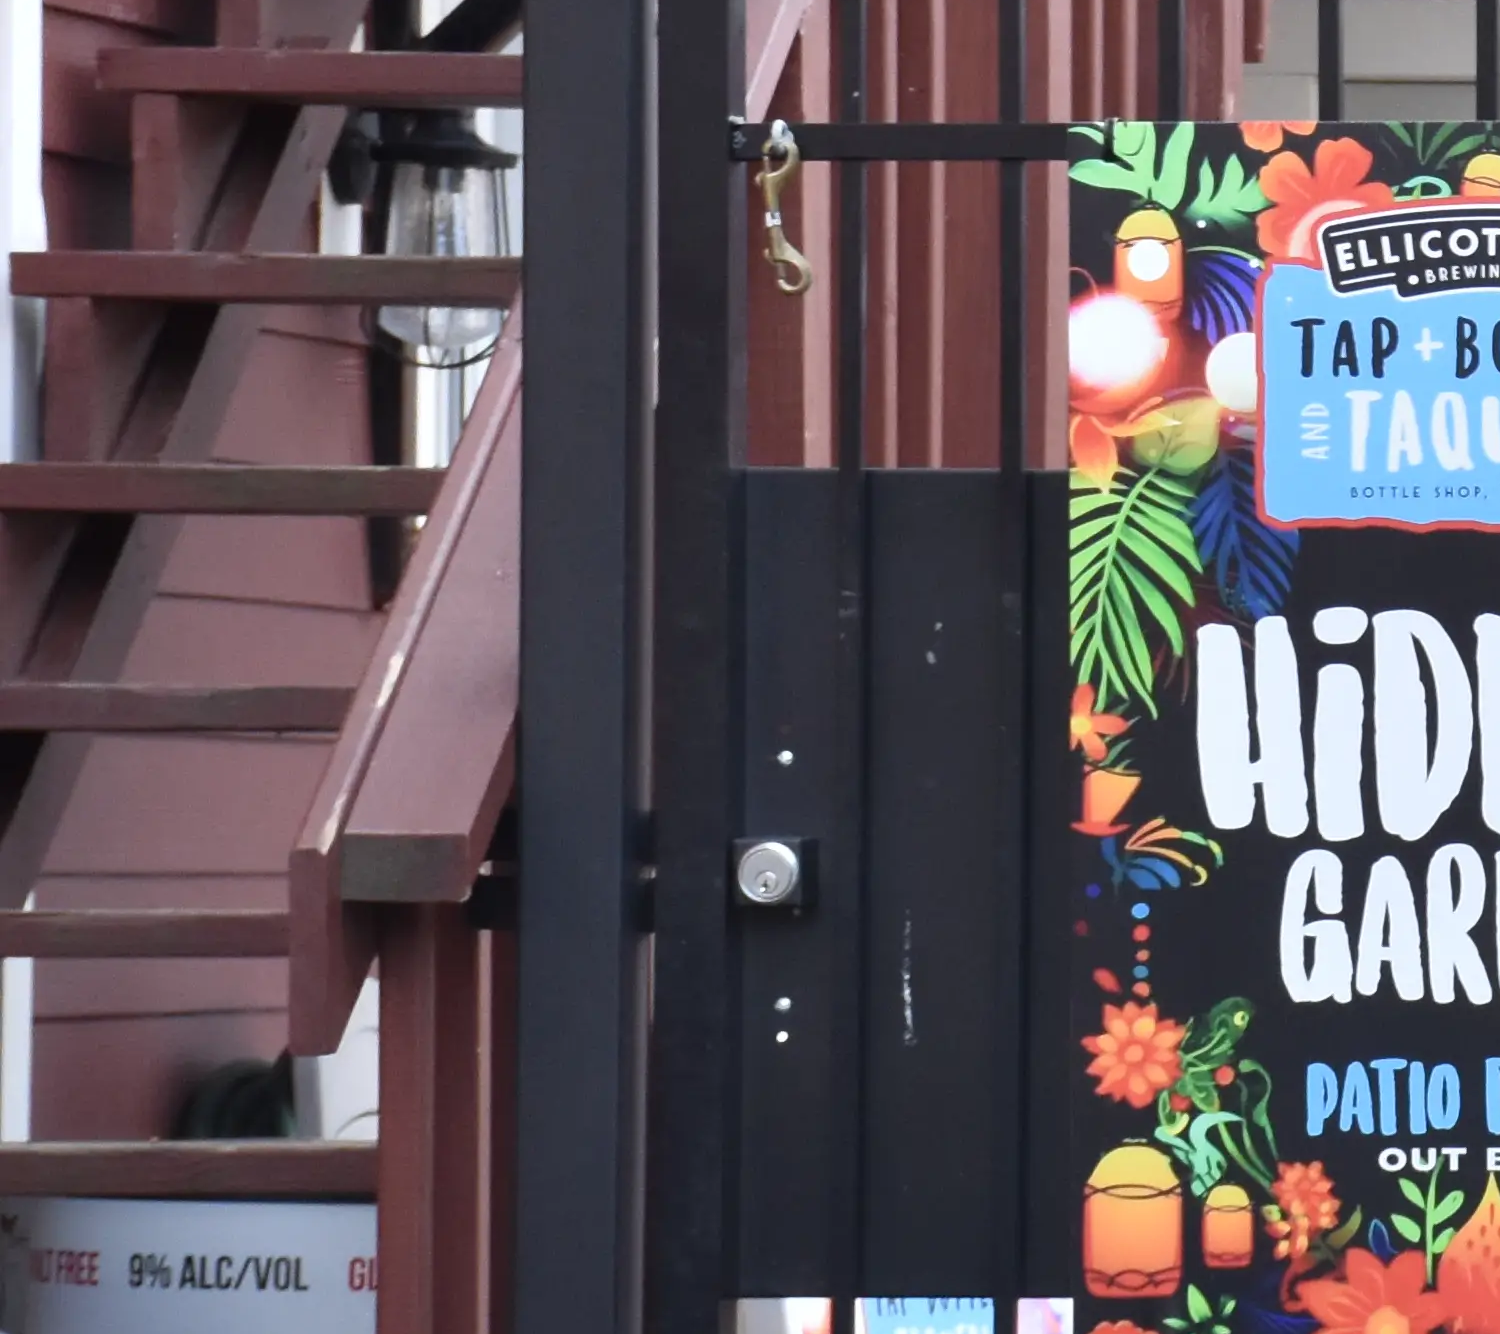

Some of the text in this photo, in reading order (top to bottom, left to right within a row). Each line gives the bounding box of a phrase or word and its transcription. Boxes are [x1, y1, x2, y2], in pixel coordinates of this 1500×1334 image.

[1290, 316, 1399, 379] TAP
[1300, 402, 1331, 460] AND
[1350, 485, 1422, 499] BOTTLE
[1434, 485, 1489, 501] SHOP,
[1306, 1058, 1461, 1136] PATIO
[1378, 1147, 1468, 1172] OUT
[128, 1253, 171, 1289] 9%
[179, 1255, 309, 1292] ALC/VOL
